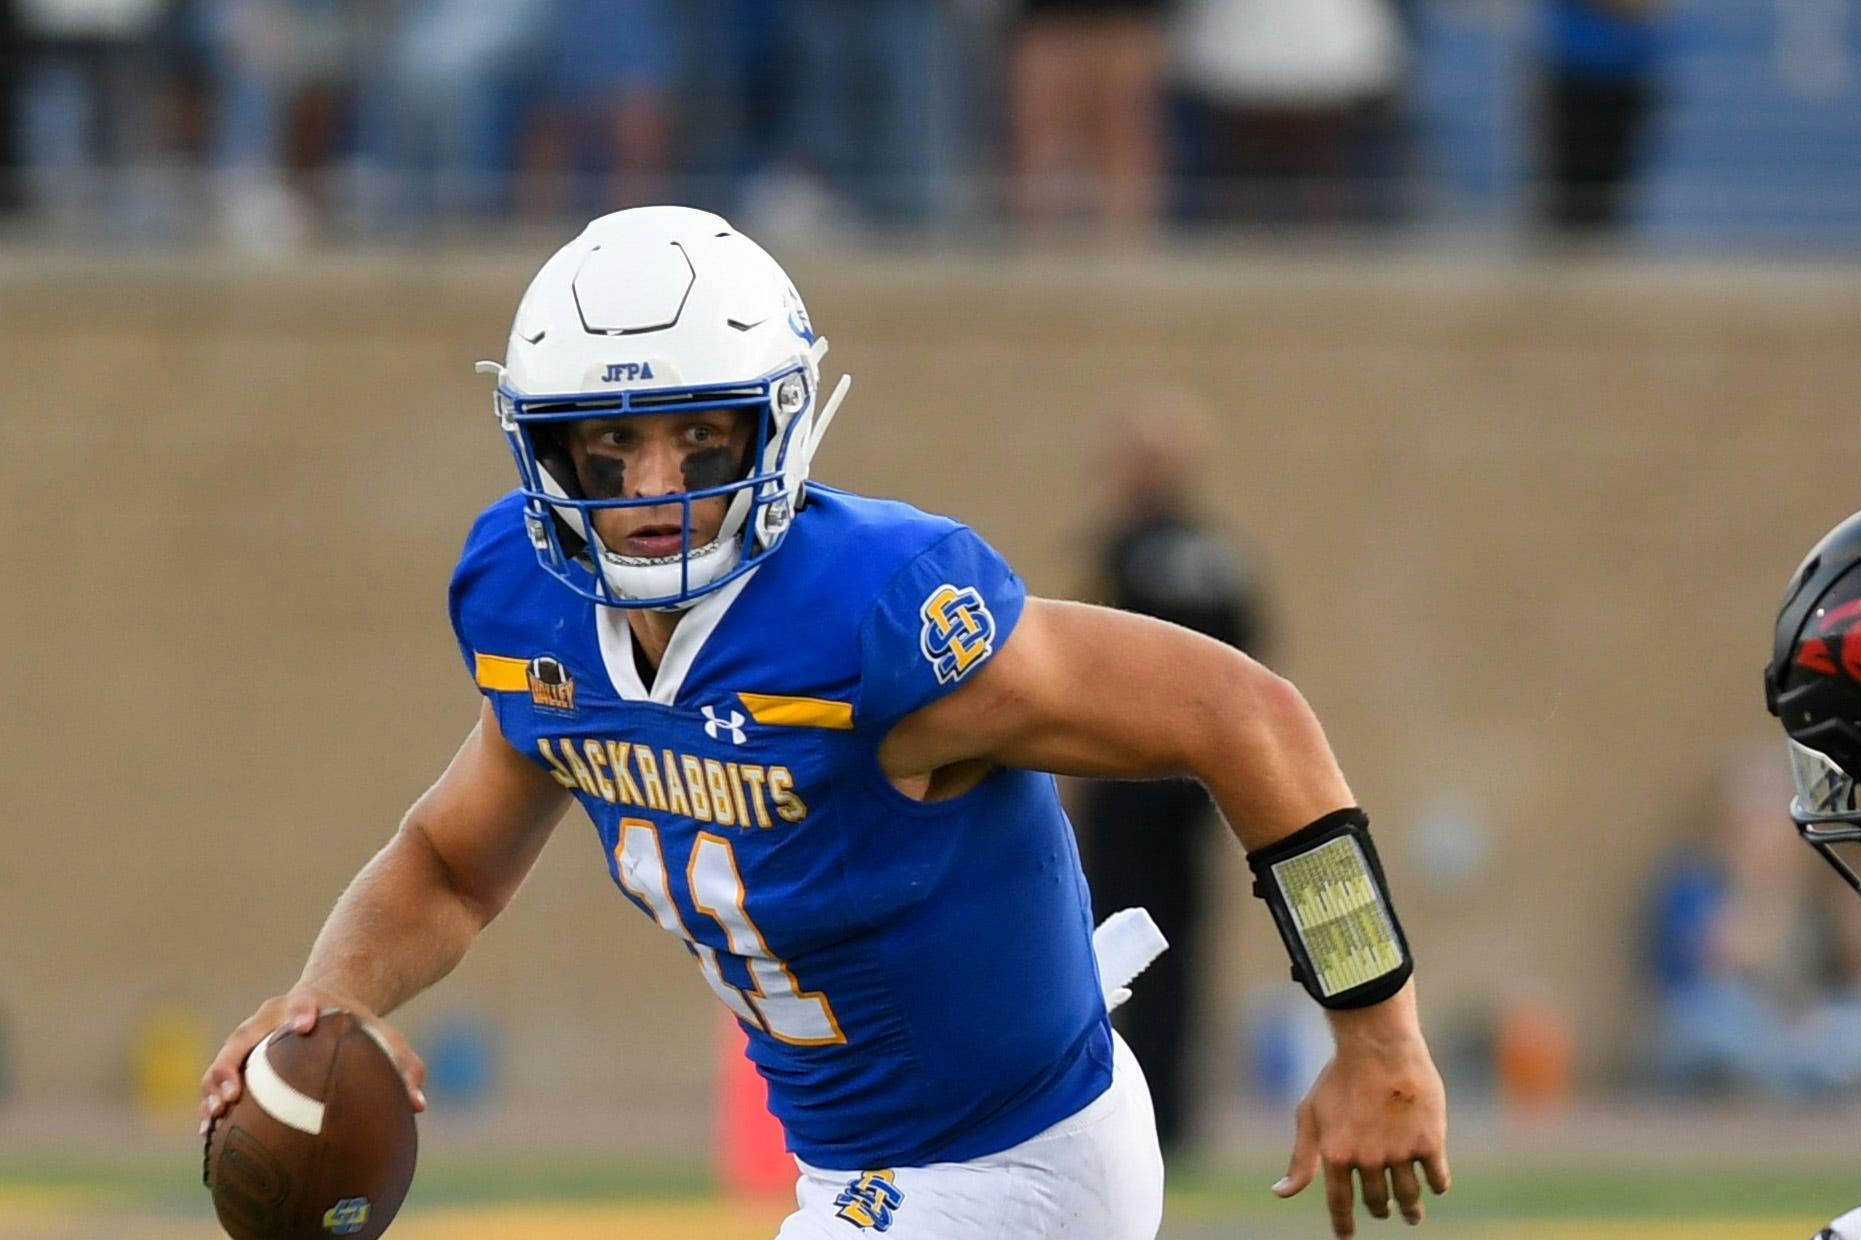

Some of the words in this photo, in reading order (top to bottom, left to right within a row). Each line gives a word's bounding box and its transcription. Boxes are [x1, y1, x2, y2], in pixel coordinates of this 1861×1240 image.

[601, 361, 654, 382] JFPA
[536, 738, 808, 829] JACKRABBITS
[614, 816, 848, 1045] 11
